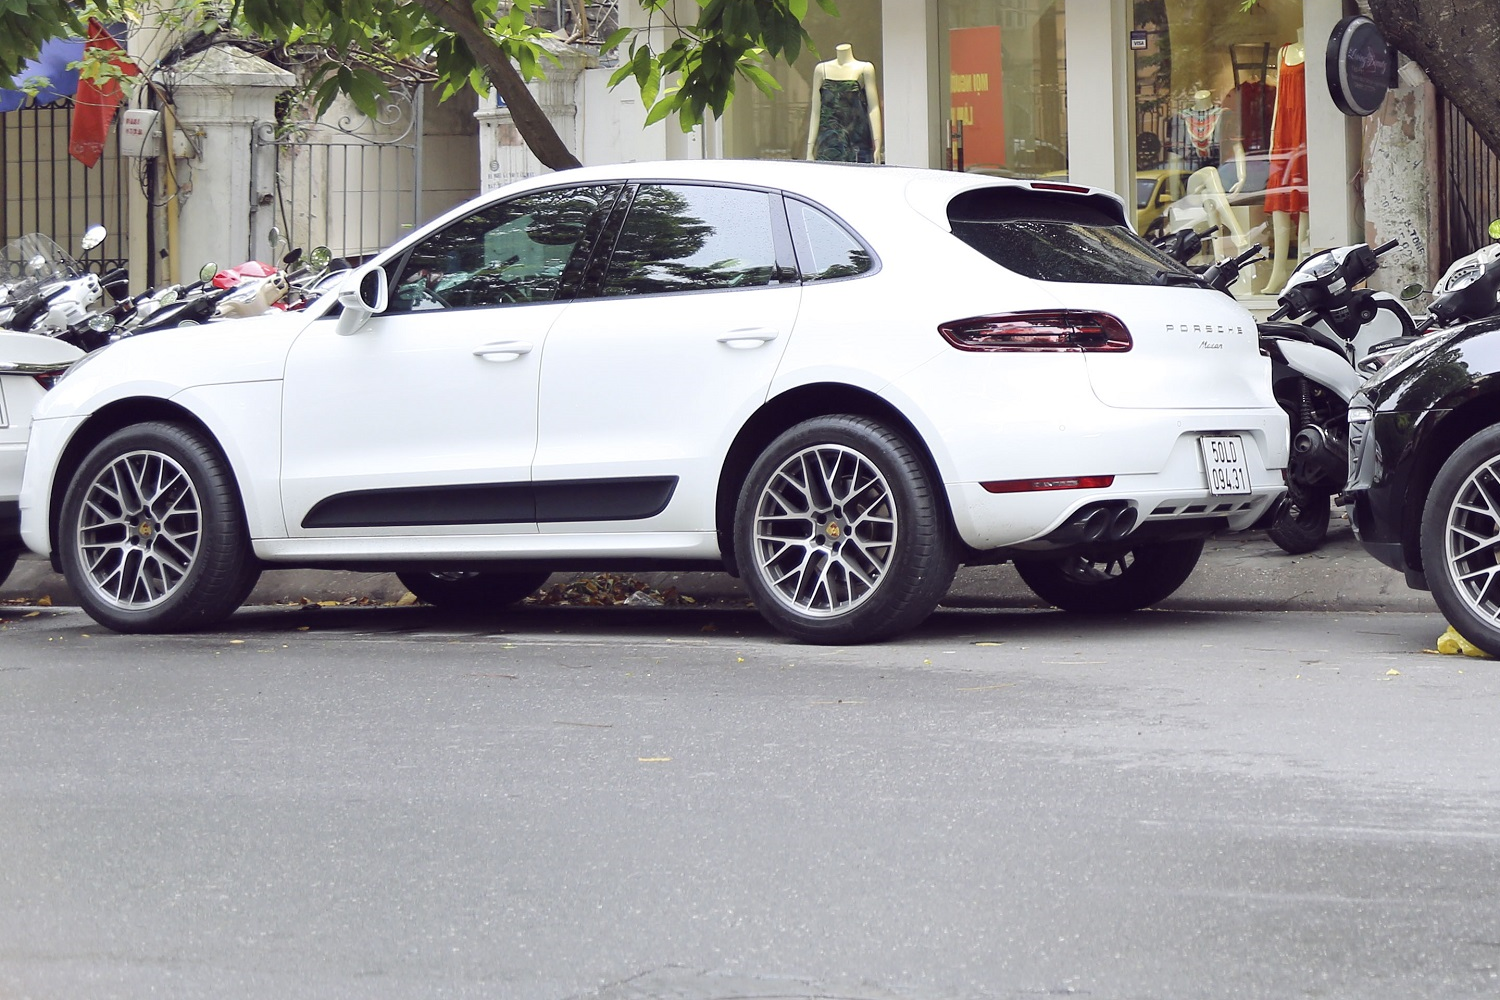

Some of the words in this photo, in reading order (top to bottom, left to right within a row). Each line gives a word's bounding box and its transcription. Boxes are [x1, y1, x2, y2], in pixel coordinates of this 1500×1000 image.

[1166, 324, 1243, 335] PORSCHE
[1211, 441, 1237, 463] 50LD
[1212, 468, 1245, 491] 094.31
